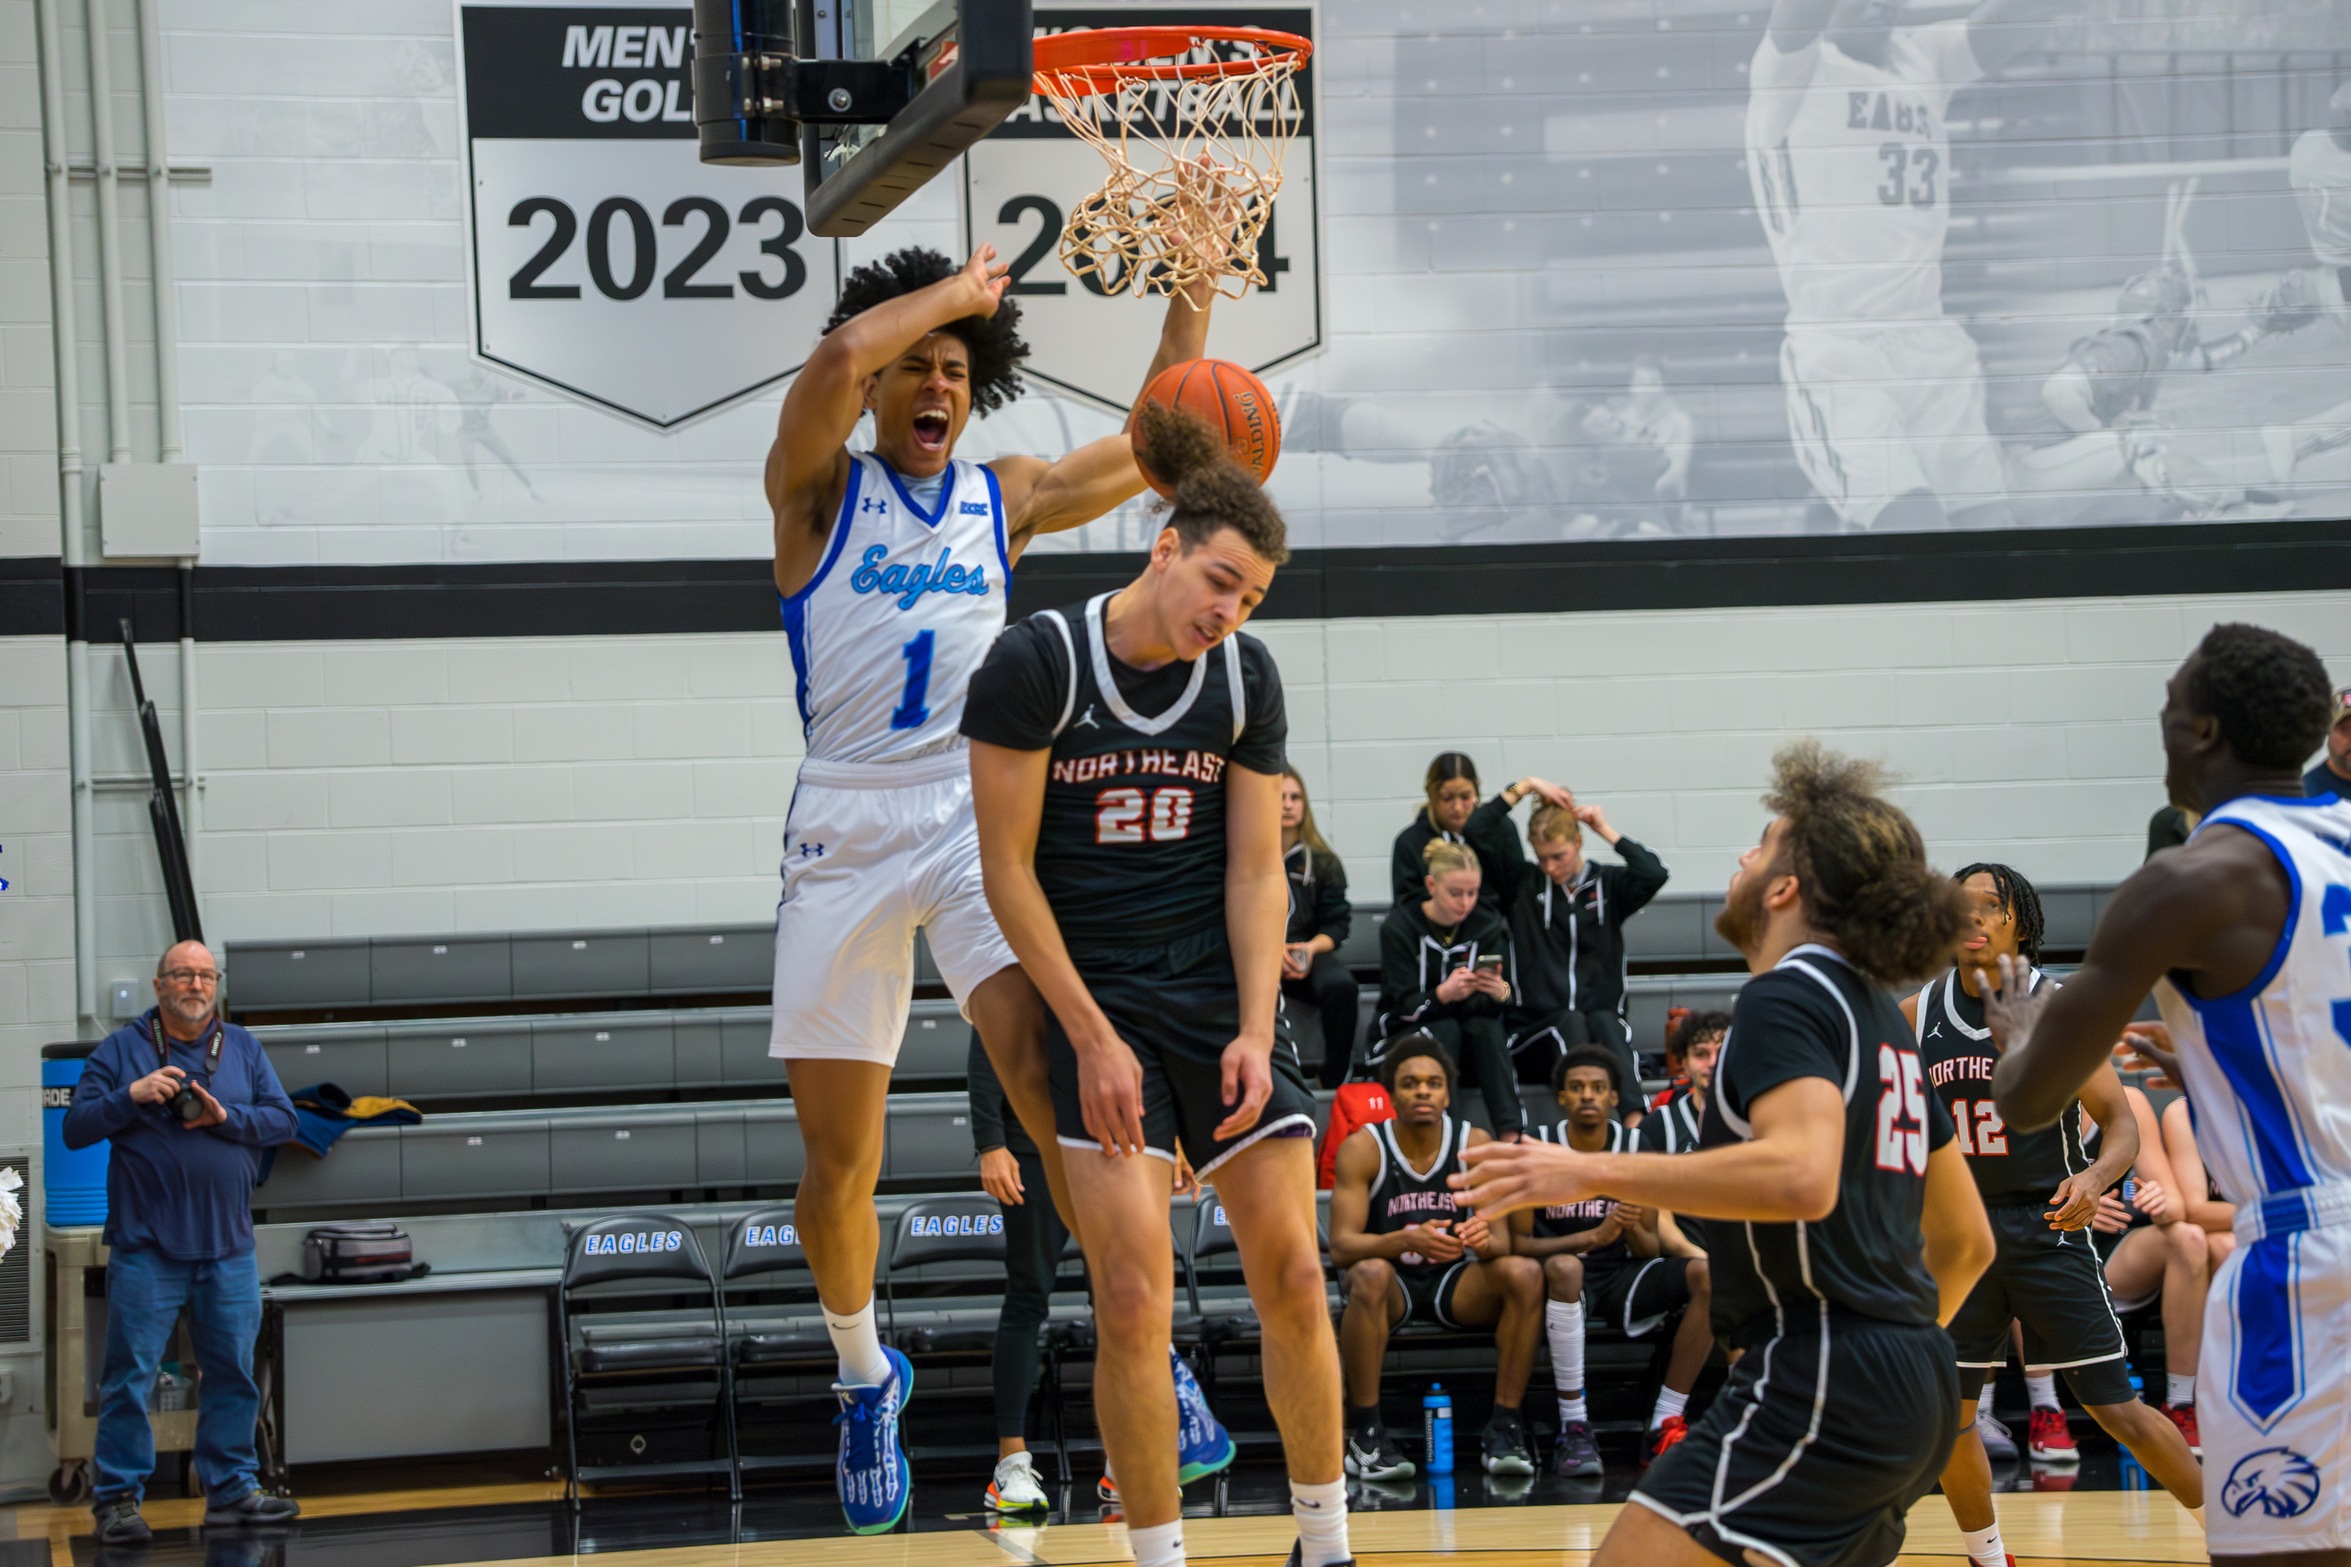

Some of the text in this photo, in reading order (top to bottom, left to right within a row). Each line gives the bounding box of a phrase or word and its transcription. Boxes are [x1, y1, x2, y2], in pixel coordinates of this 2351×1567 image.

[582, 79, 697, 122] GOL
[1878, 142, 1939, 210] 33
[508, 195, 807, 300] 2023
[1233, 391, 1265, 474] ALDING
[851, 544, 990, 610] Eagles
[889, 629, 935, 731] 1
[1053, 748, 1226, 783] NORTHEAST
[1095, 786, 1194, 844] 20
[1875, 1042, 1930, 1178] 25
[1951, 1099, 2009, 1156] 12
[585, 1230, 683, 1255] EAGLES
[745, 1224, 801, 1247] EAG
[911, 1214, 1004, 1236] EAGLES
